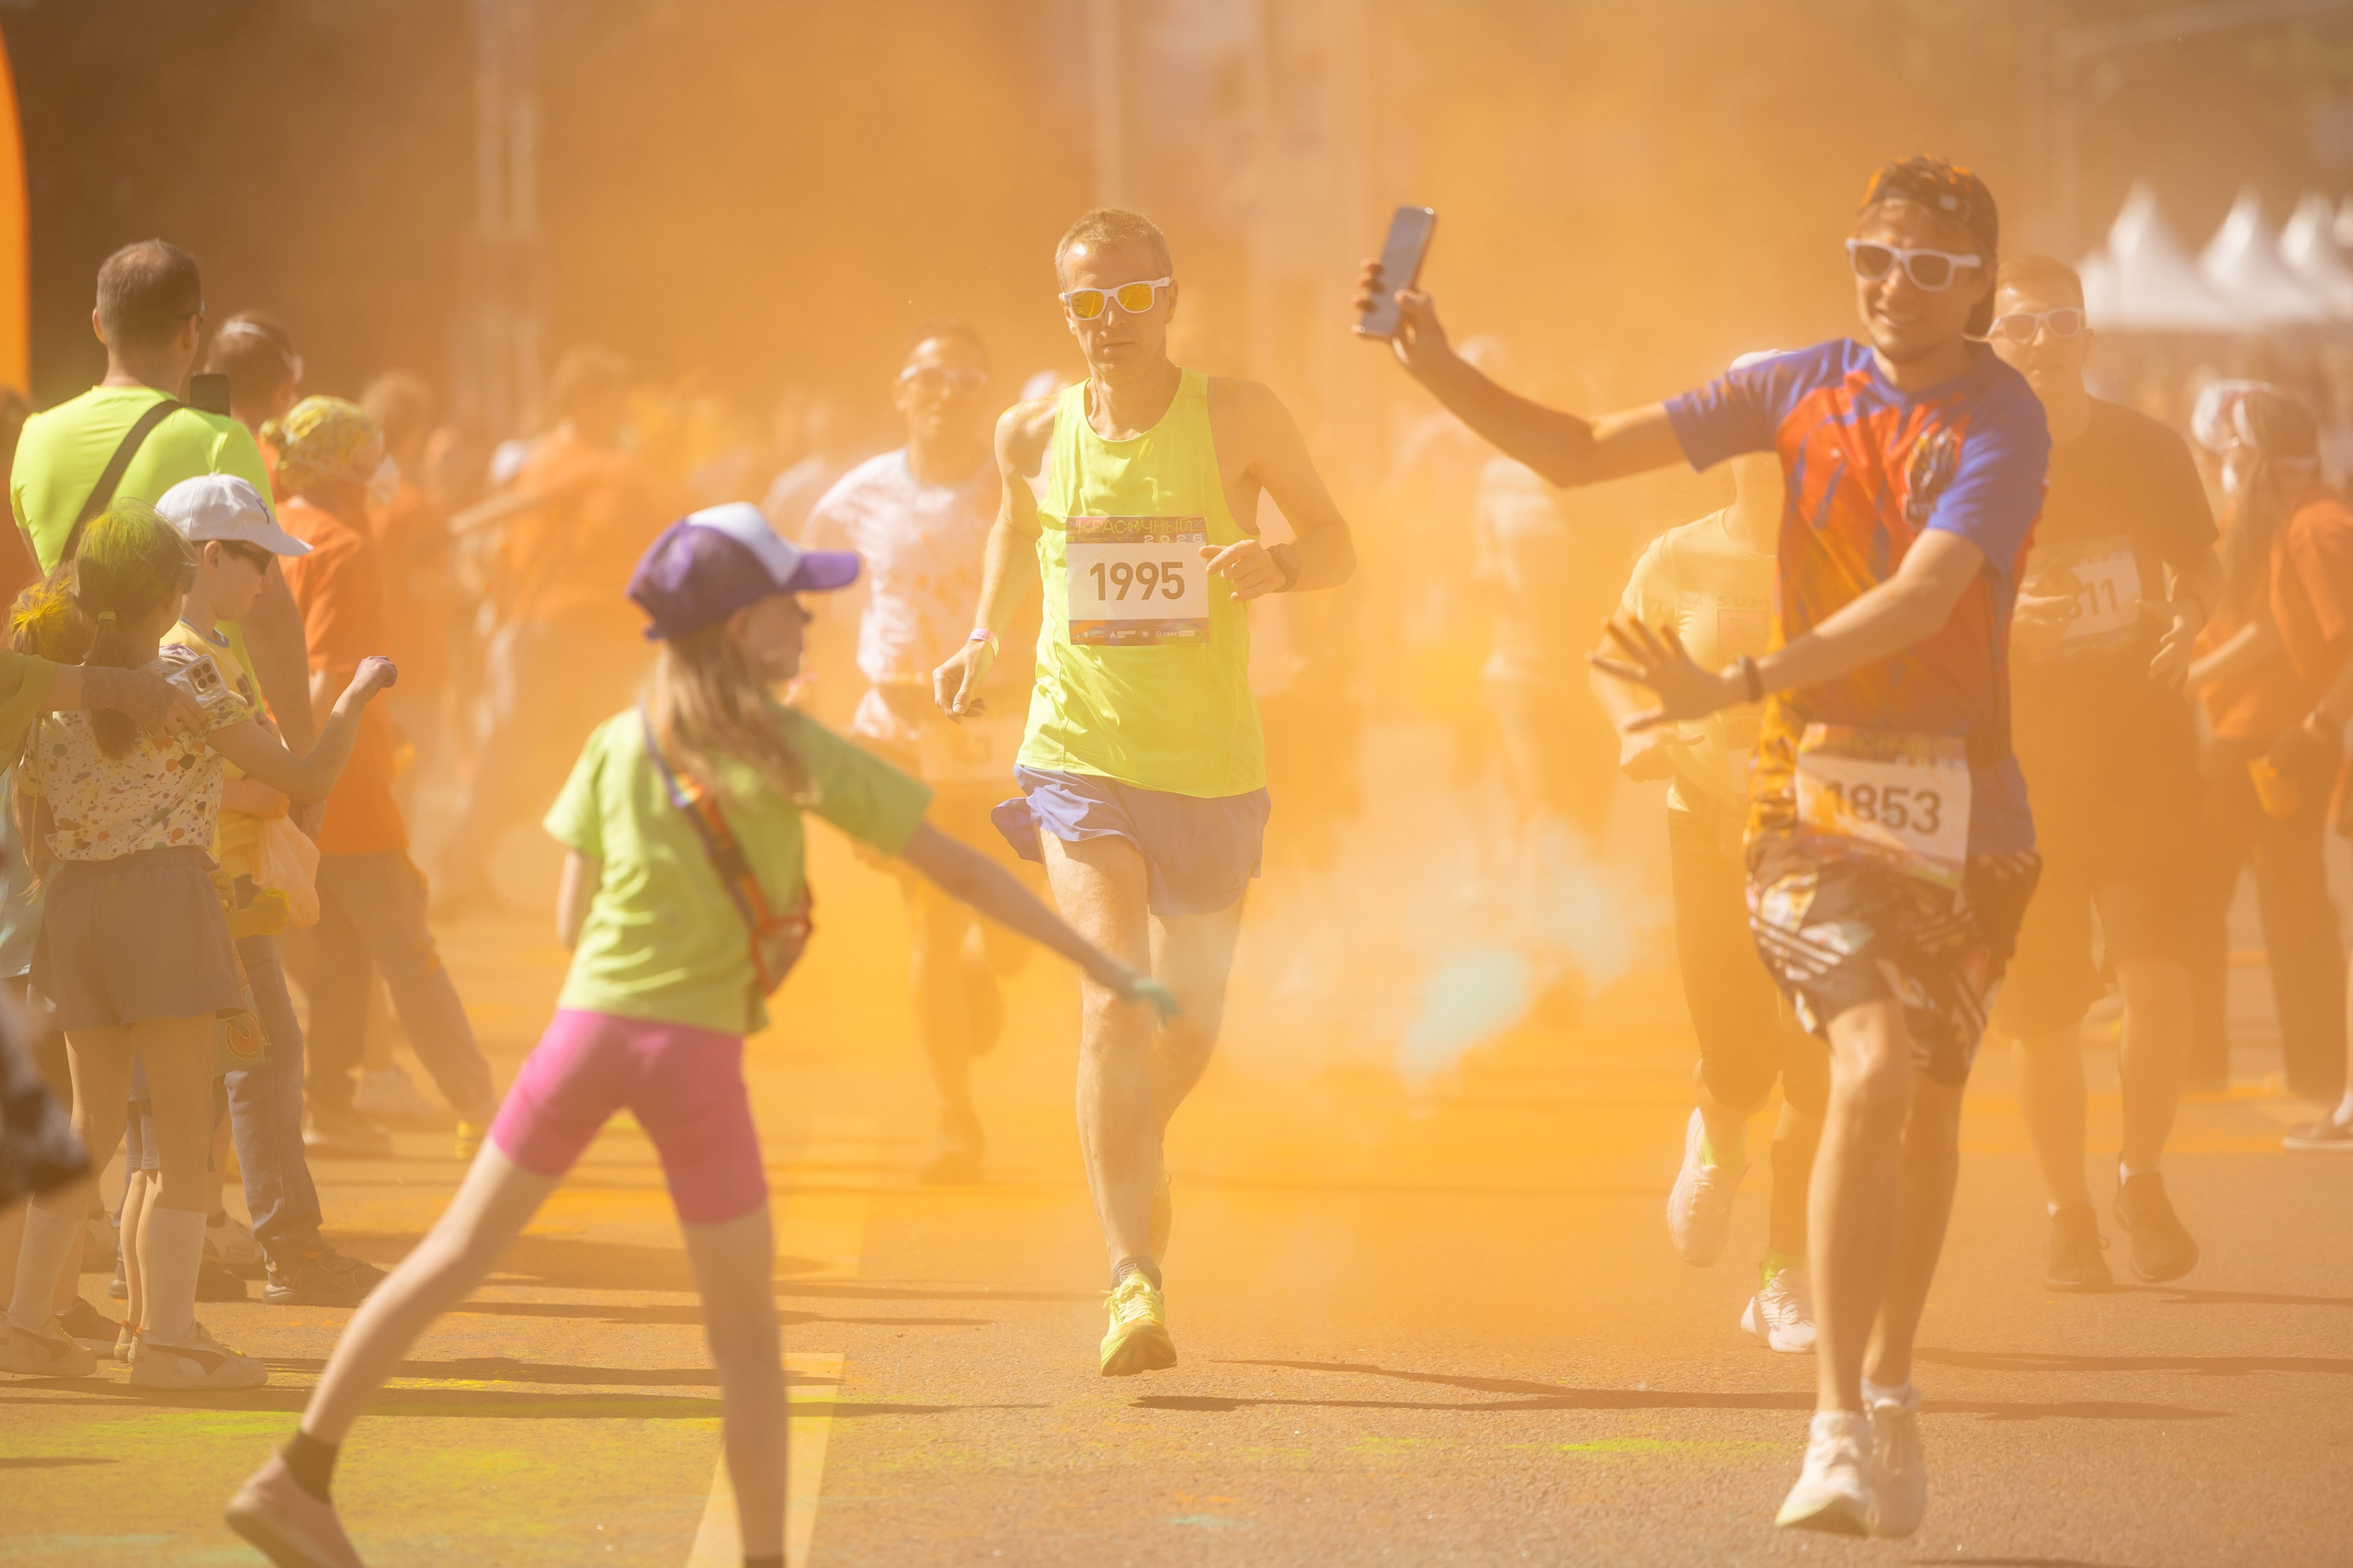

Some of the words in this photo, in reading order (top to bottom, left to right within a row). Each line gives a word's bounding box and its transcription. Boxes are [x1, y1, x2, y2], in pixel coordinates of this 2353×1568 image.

[1143, 534, 1203, 544] 2026
[1089, 562, 1185, 601] 1995
[1825, 780, 1942, 836] 1853
